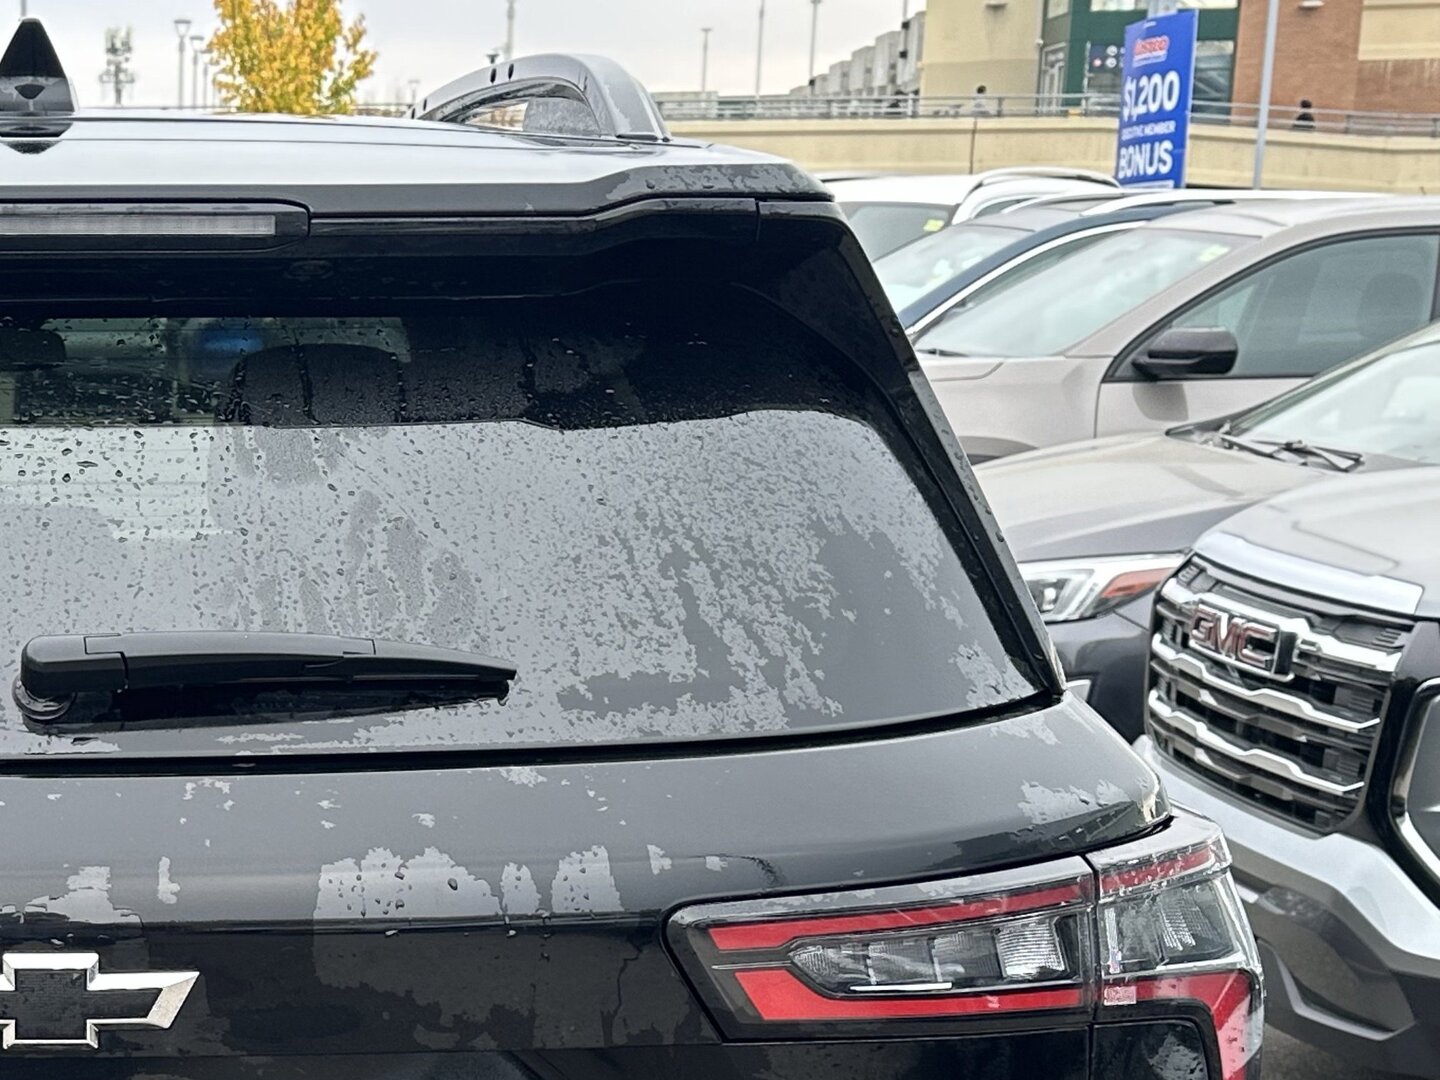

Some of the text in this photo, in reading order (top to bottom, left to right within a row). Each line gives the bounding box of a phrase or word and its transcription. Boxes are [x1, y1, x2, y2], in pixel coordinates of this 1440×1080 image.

[1123, 70, 1180, 122] $1,200
[1118, 140, 1173, 179] BONUS
[1190, 605, 1278, 671] GMC
